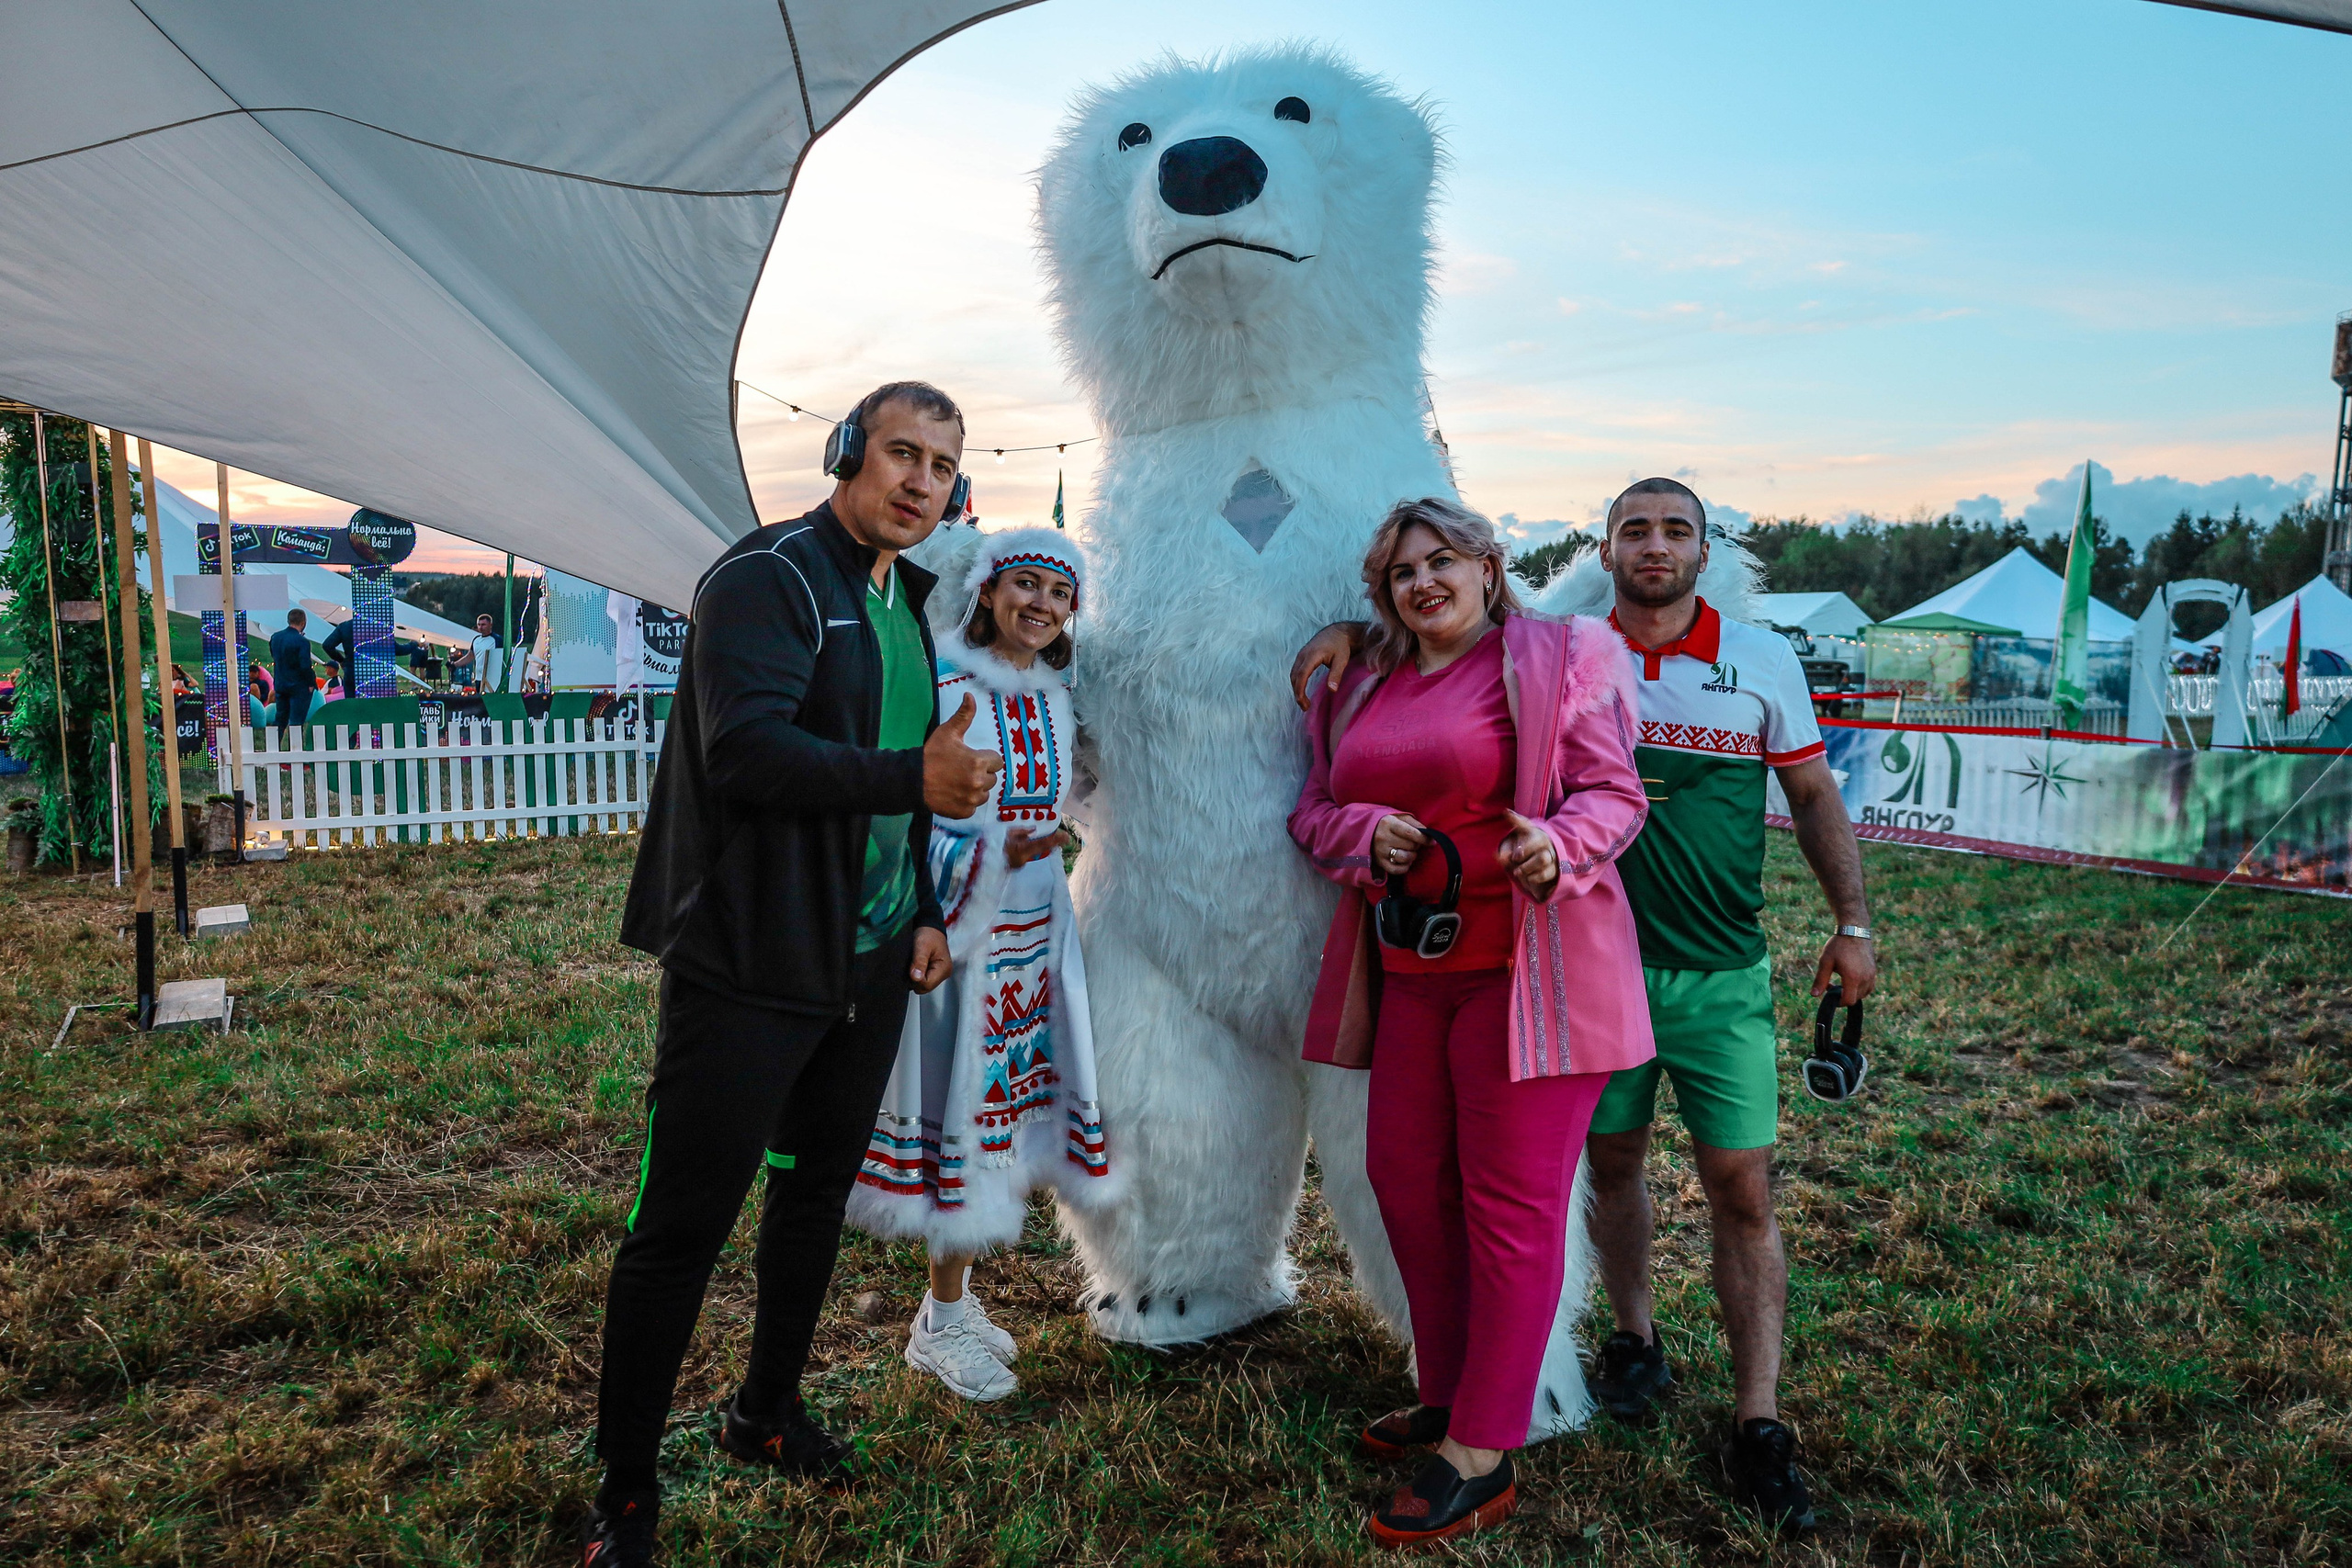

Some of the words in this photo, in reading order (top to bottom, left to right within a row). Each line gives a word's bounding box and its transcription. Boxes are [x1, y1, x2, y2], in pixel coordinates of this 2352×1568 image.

[351, 522, 413, 536] Нормально
[371, 536, 391, 548] всё!
[646, 622, 688, 637] TikTo
[659, 639, 685, 650] PAR
[419, 706, 440, 716] ТАВЬ
[176, 719, 199, 738] сё!
[1860, 805, 1956, 834] ЯНГПУР
